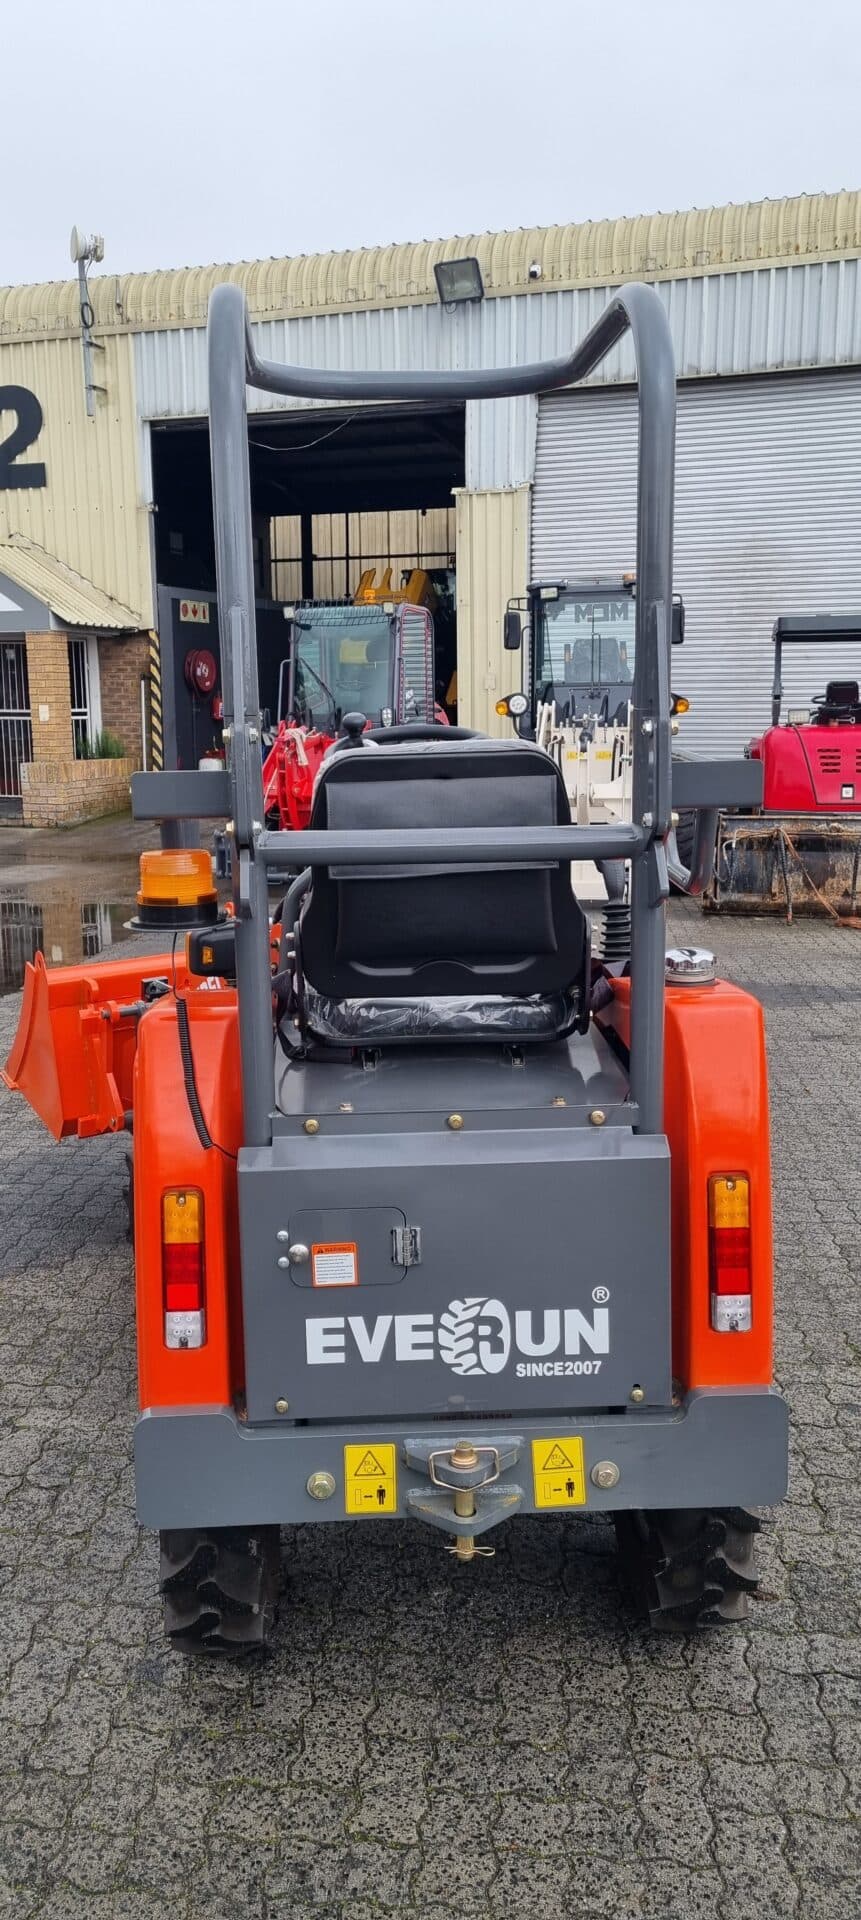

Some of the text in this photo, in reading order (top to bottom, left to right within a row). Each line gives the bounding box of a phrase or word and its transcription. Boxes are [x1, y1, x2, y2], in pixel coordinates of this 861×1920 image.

[0, 385, 47, 490] 2
[305, 1297, 610, 1375] EVERUN
[515, 1360, 602, 1378] SINCE2007
